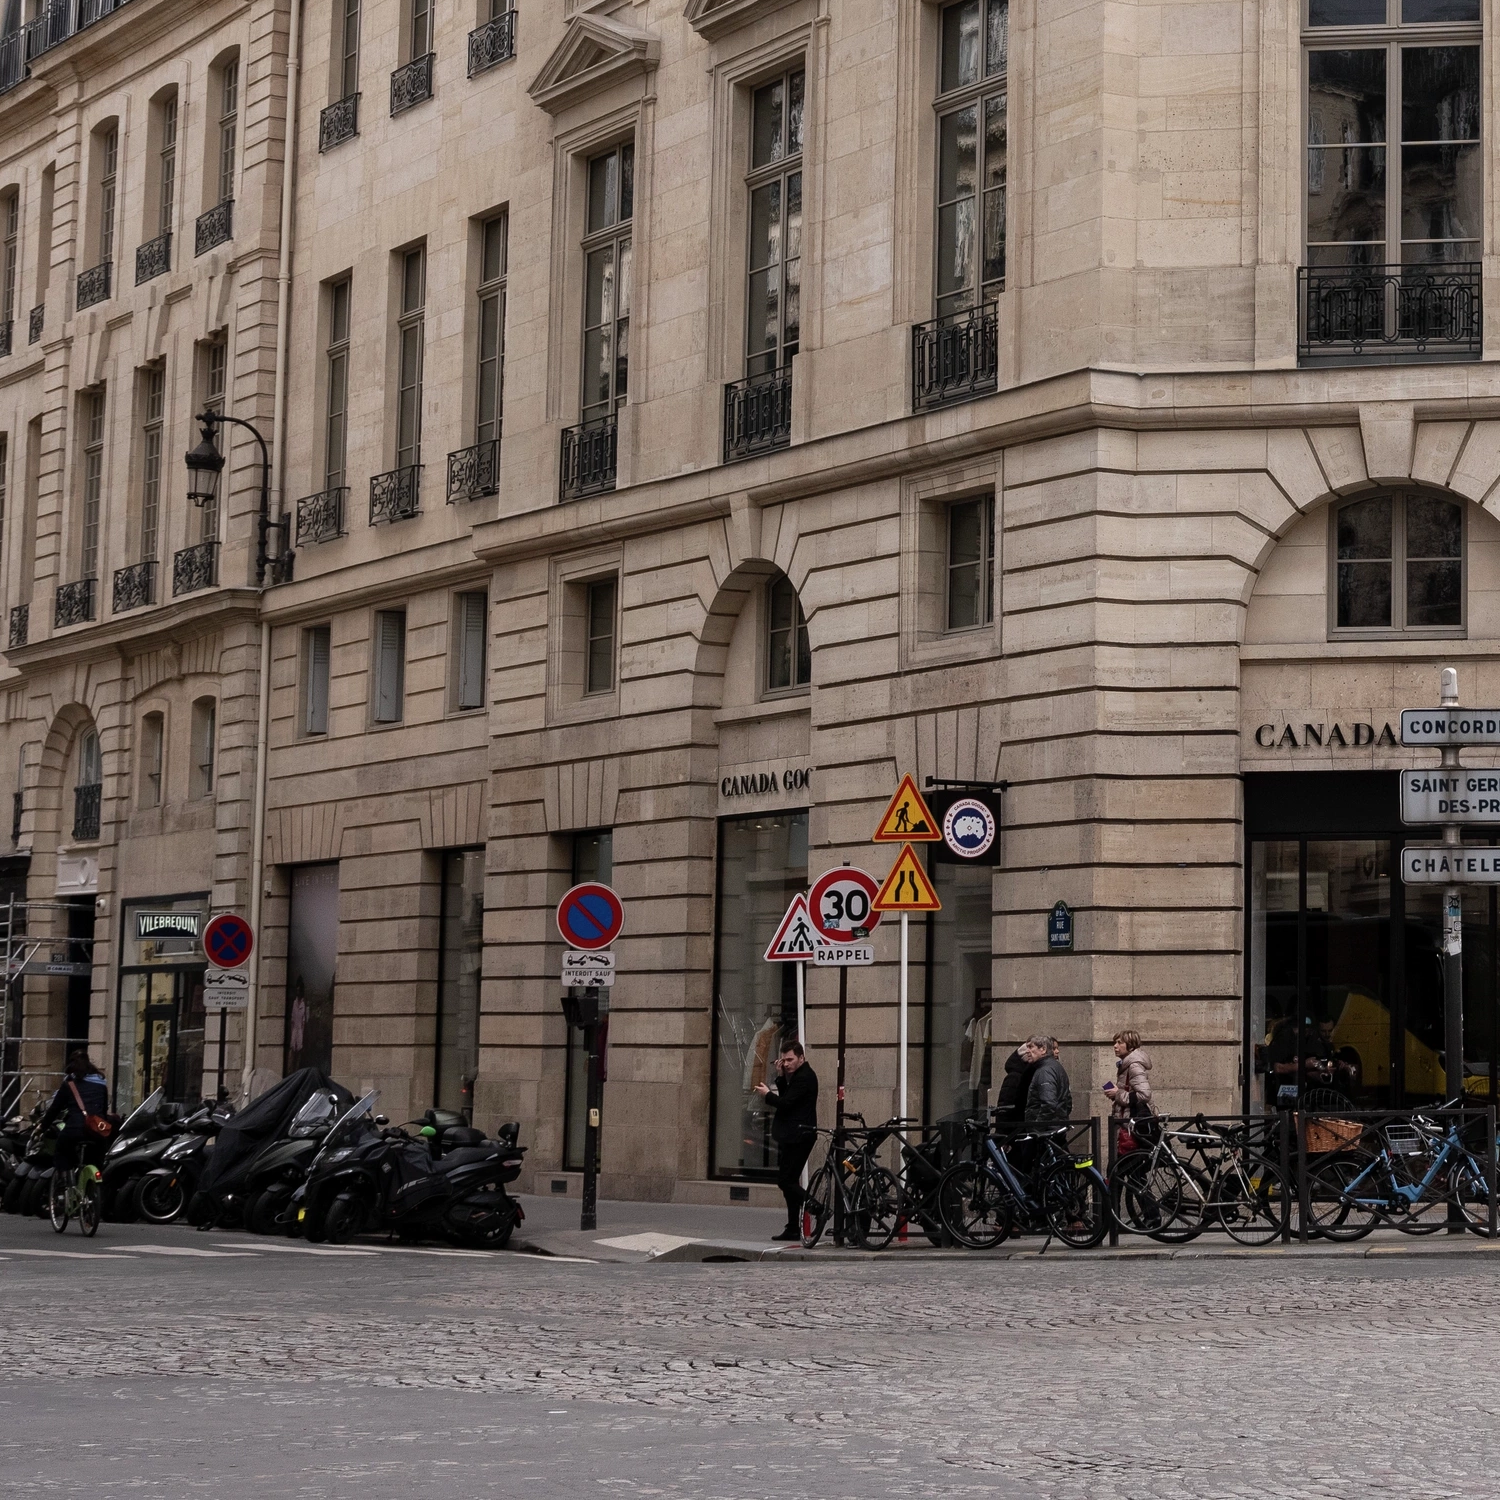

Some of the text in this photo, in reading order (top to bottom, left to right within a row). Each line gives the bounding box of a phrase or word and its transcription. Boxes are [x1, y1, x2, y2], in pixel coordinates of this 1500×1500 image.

[1255, 722, 1400, 748] CANADA
[721, 771, 779, 797] CANADA
[1410, 778, 1459, 793] SAINT
[823, 889, 869, 921] 30
[139, 915, 198, 936] VILEBREQUIN
[818, 950, 870, 961] RAPPEL
